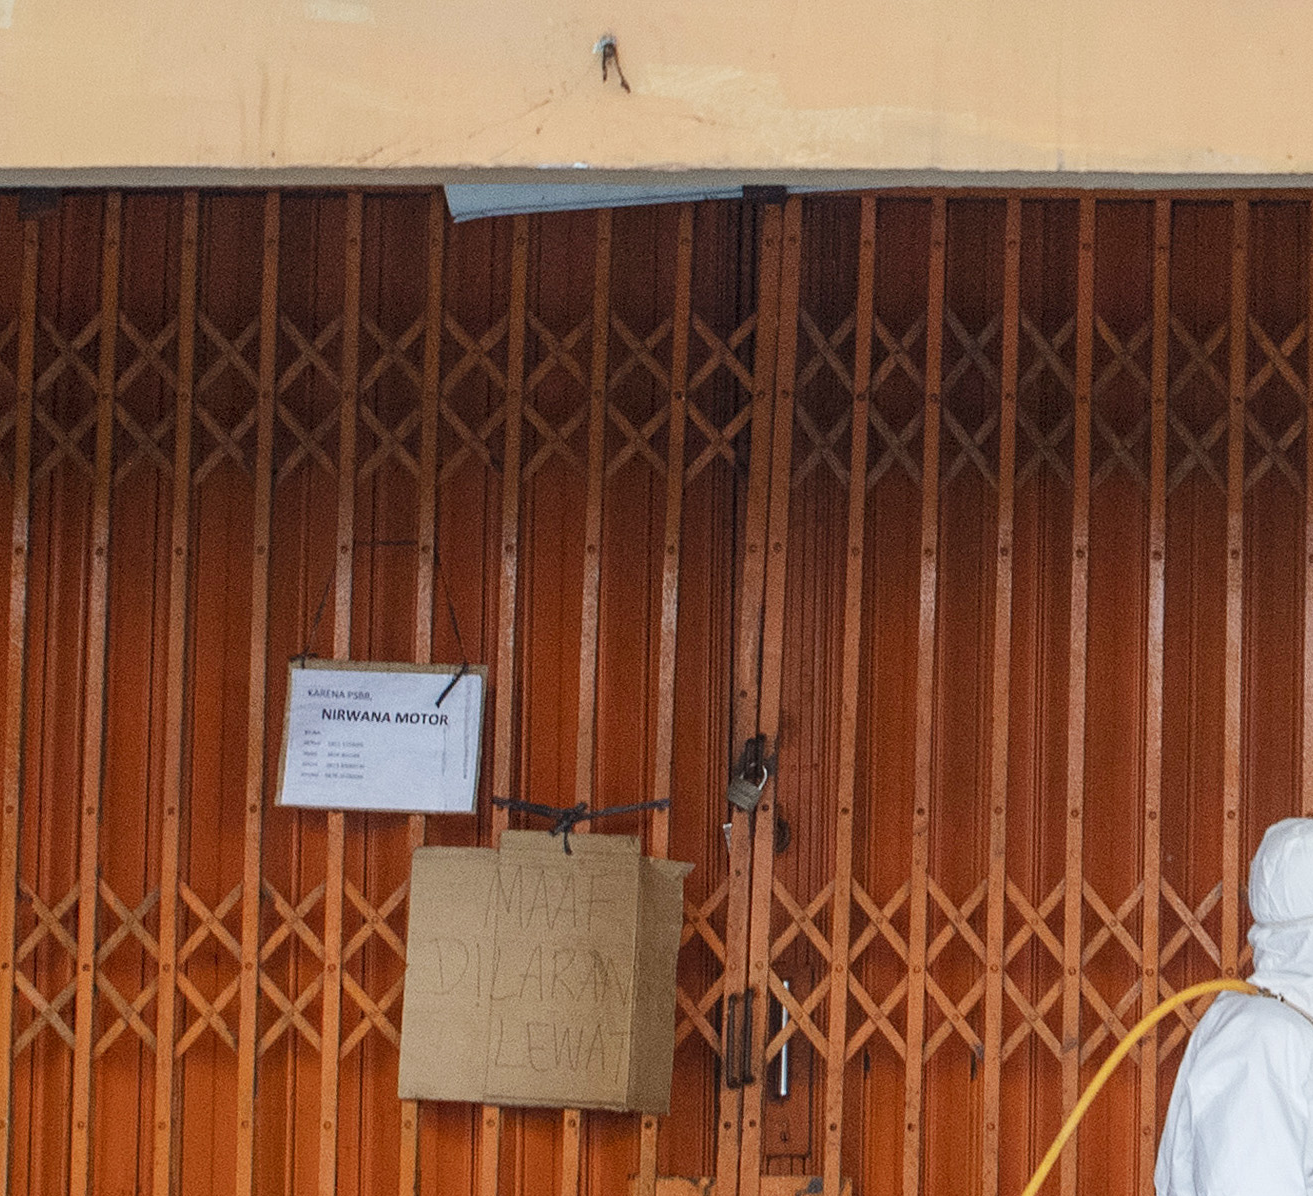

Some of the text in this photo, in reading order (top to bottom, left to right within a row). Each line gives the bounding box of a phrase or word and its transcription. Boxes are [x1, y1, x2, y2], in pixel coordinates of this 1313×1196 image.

[307, 688, 345, 699] KARENA
[321, 708, 449, 726] NIRWANA MOTOR
